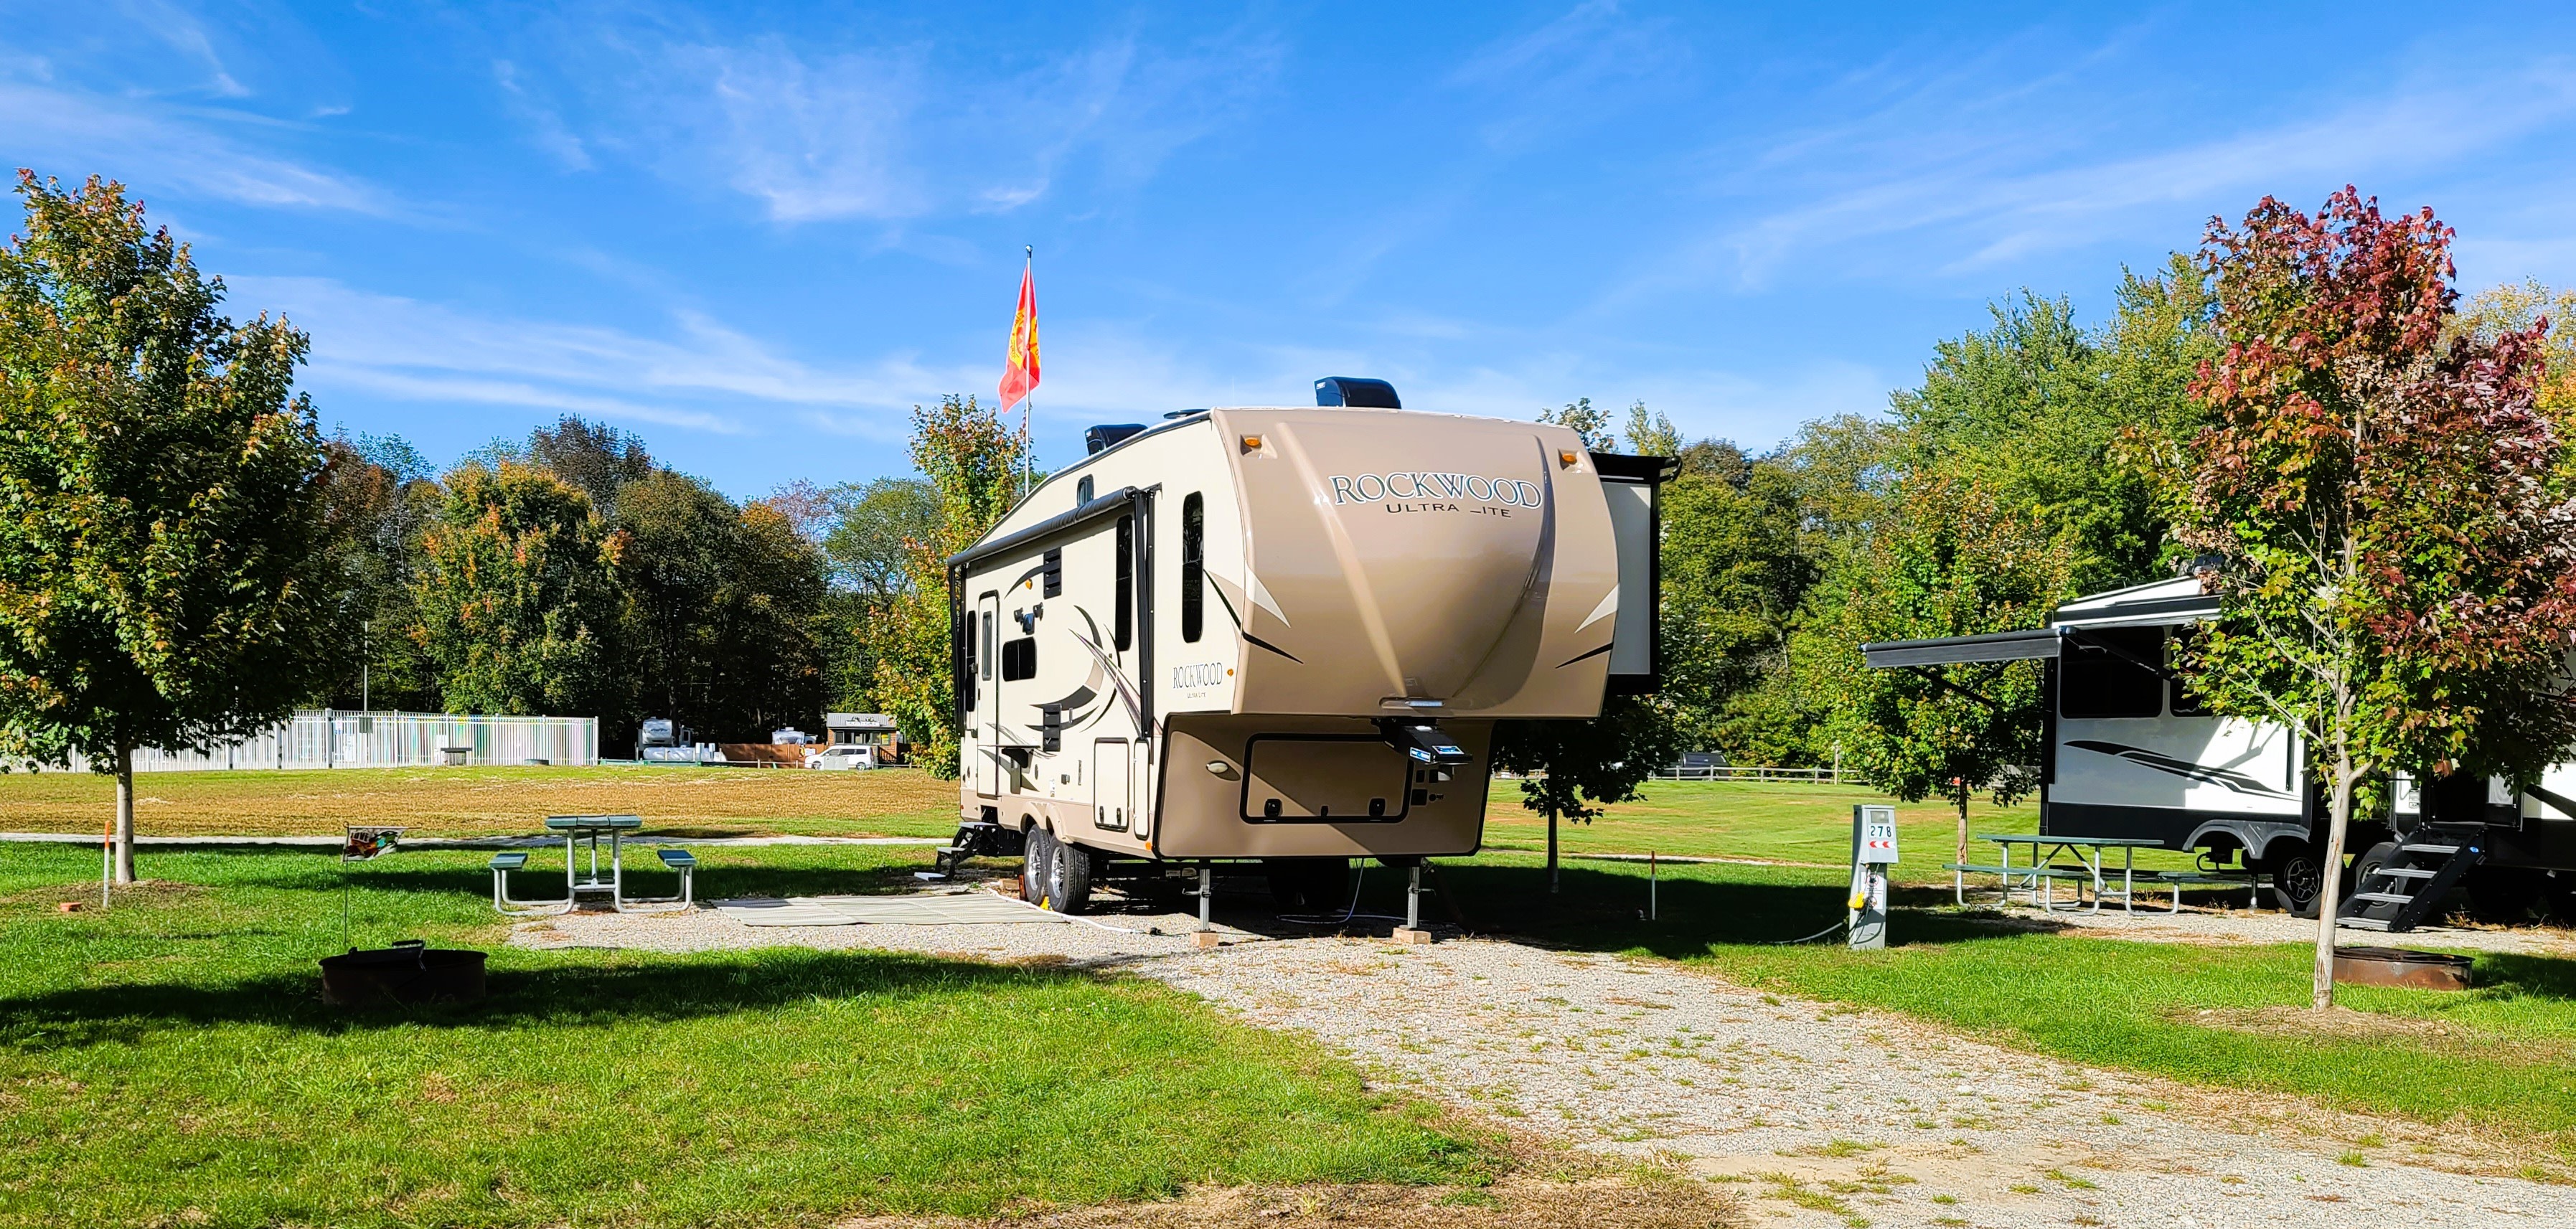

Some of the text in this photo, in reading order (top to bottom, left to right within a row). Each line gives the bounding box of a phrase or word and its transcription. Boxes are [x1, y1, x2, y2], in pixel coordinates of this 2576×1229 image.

[1328, 471, 1543, 509] ROCKWOOD
[1386, 503, 1459, 514] ULTRA
[1173, 662, 1223, 689] ROCKWOOD
[1870, 825, 1892, 838] 278
